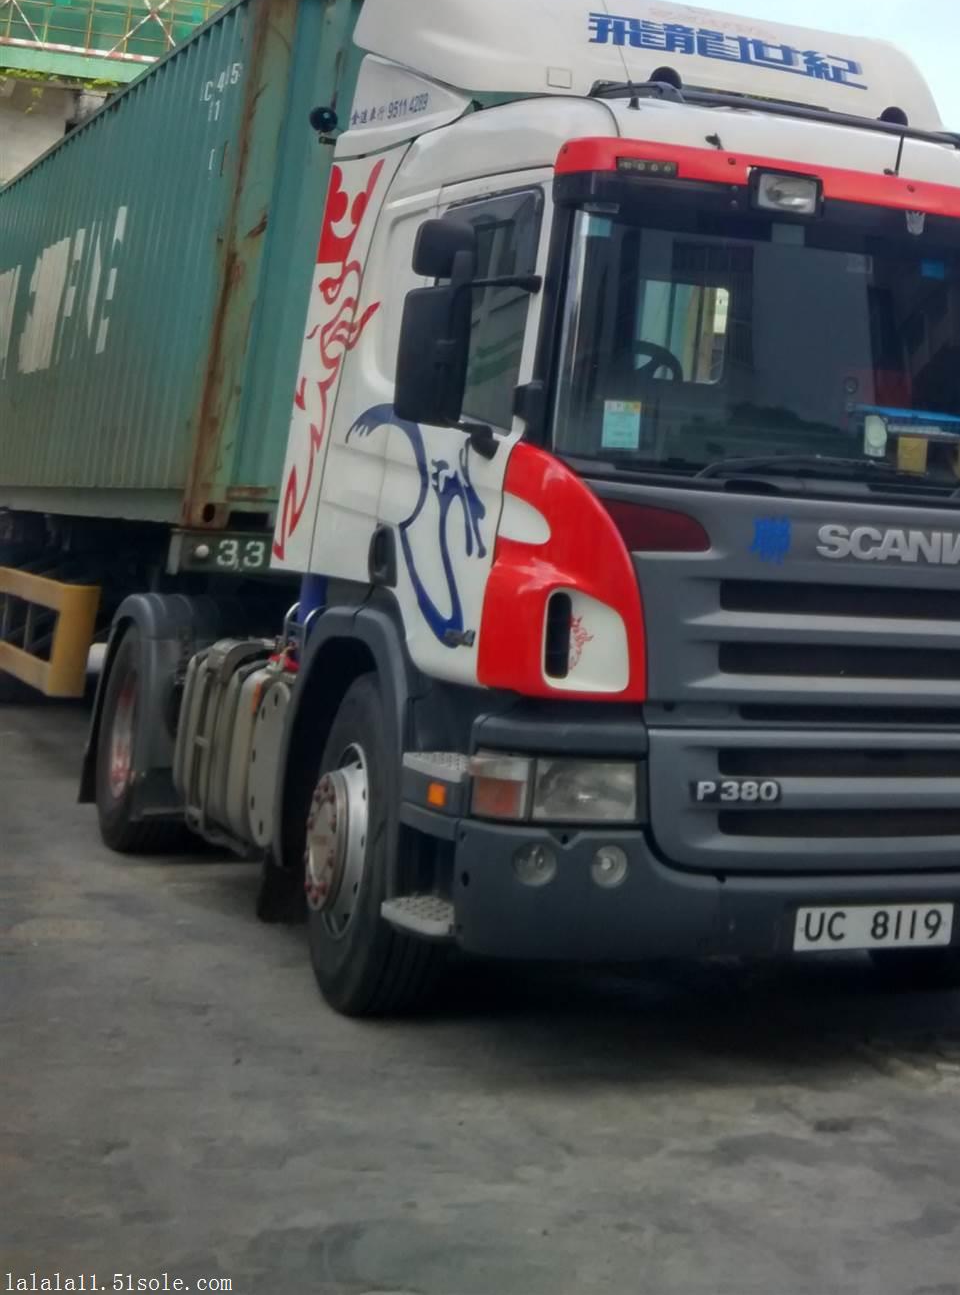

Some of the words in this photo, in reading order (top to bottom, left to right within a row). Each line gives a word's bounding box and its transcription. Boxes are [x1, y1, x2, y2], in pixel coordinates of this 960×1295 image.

[588, 11, 869, 91] 飛龍世紀
[696, 780, 717, 801] P
[720, 780, 779, 801] 380
[803, 910, 847, 943] UC
[870, 908, 943, 941] 8119
